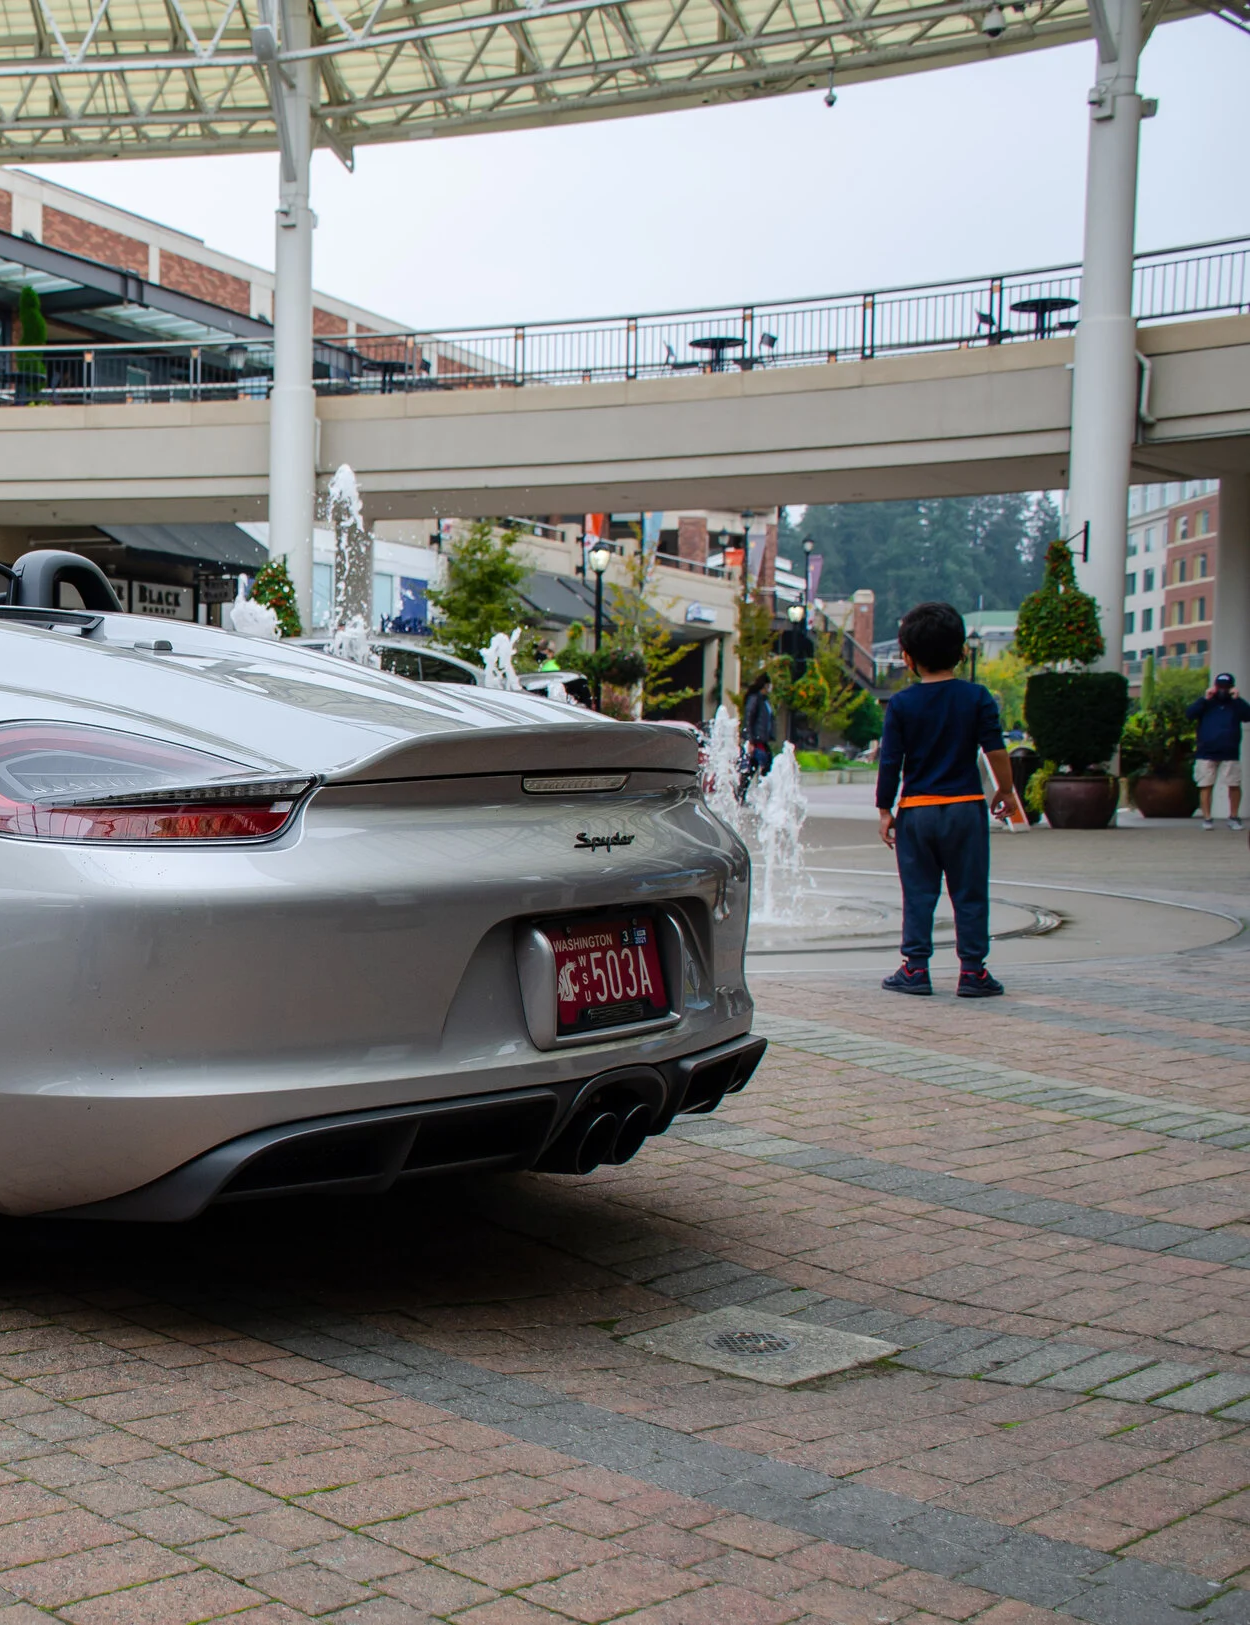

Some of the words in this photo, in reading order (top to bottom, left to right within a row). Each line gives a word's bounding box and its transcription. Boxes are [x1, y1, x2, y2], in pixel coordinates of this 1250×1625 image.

[138, 584, 181, 607] BLACK
[574, 831, 635, 853] Spyder
[553, 933, 613, 953] WASHINGTON
[590, 946, 654, 1002] 503A
